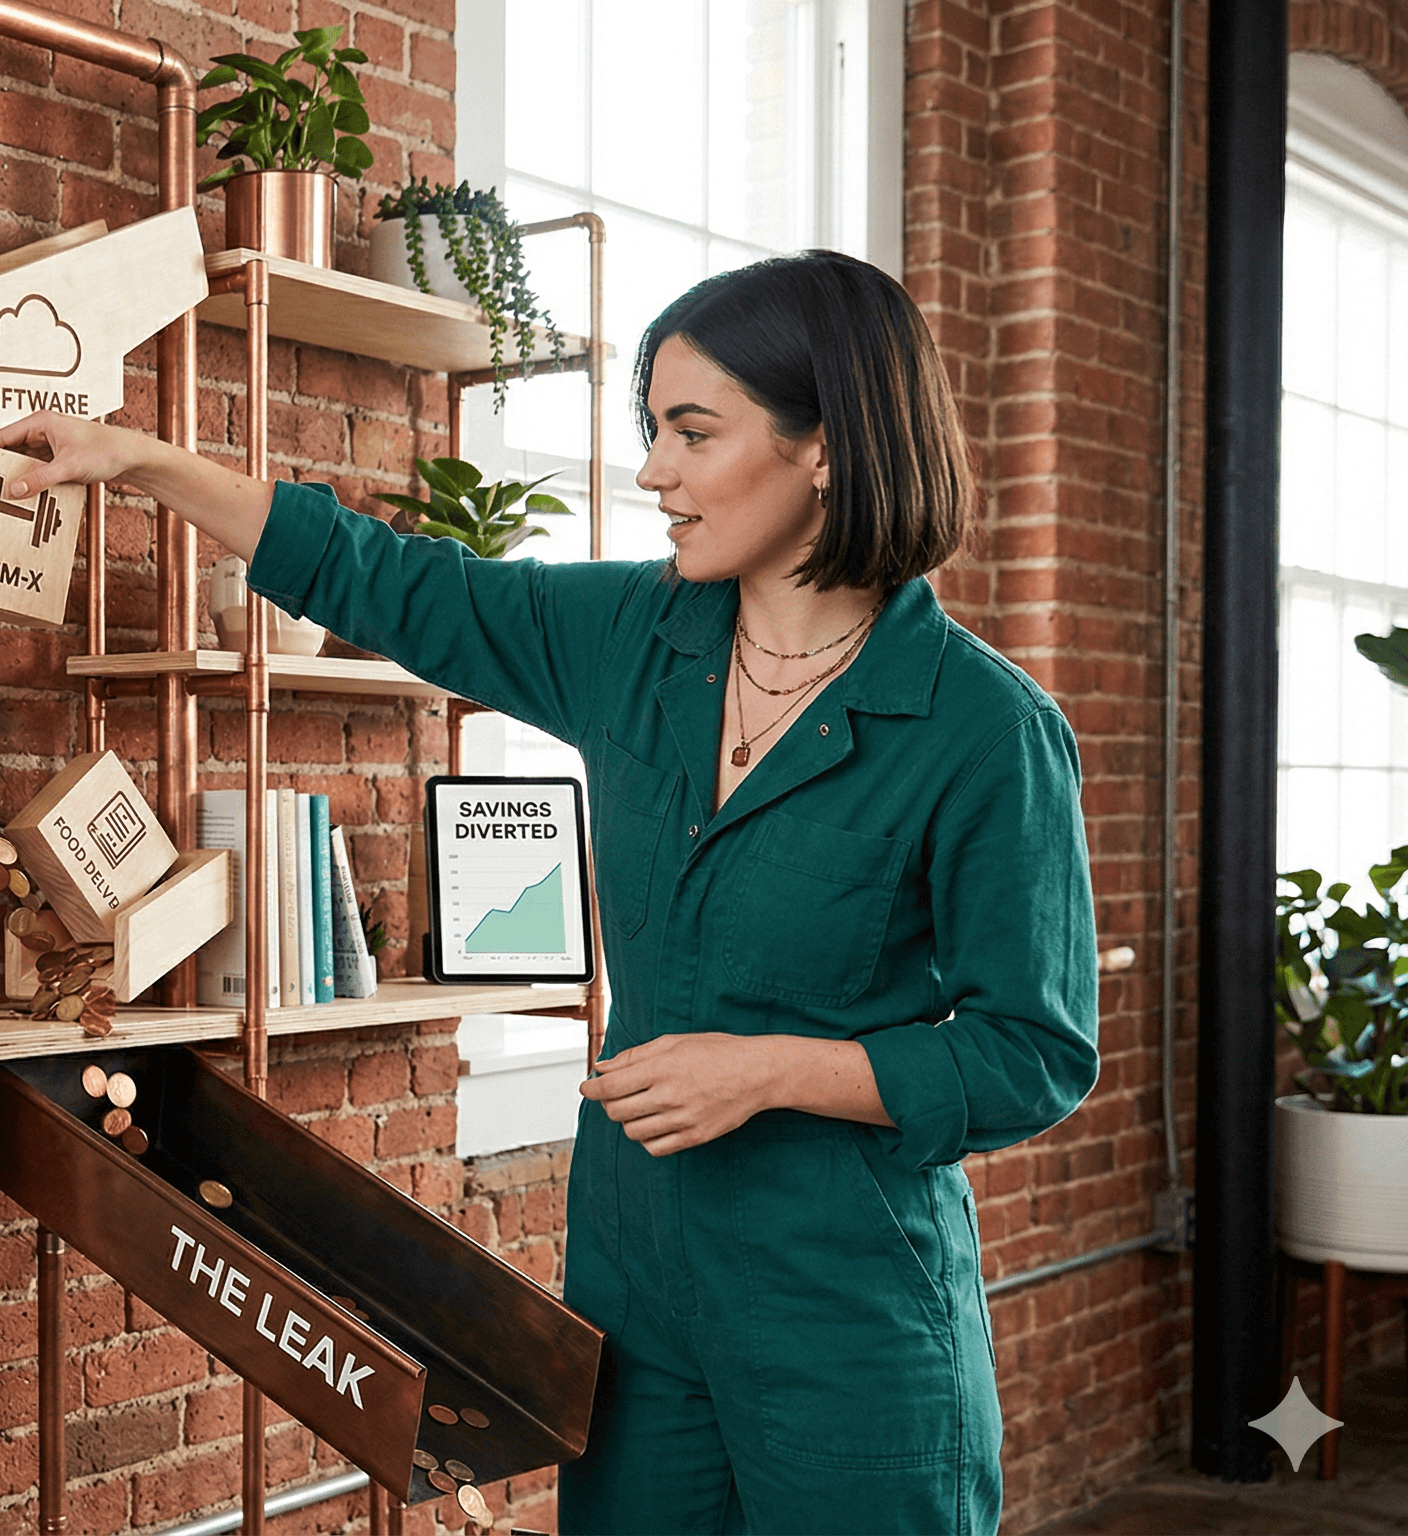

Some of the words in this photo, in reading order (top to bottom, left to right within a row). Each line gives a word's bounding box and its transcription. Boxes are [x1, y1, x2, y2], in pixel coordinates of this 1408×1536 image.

[459, 801, 552, 818] SAVINGS
[52, 816, 87, 862] FOOD
[455, 823, 558, 840] DIVERTED
[170, 1224, 251, 1317] THE
[255, 1292, 376, 1411] LEAK
